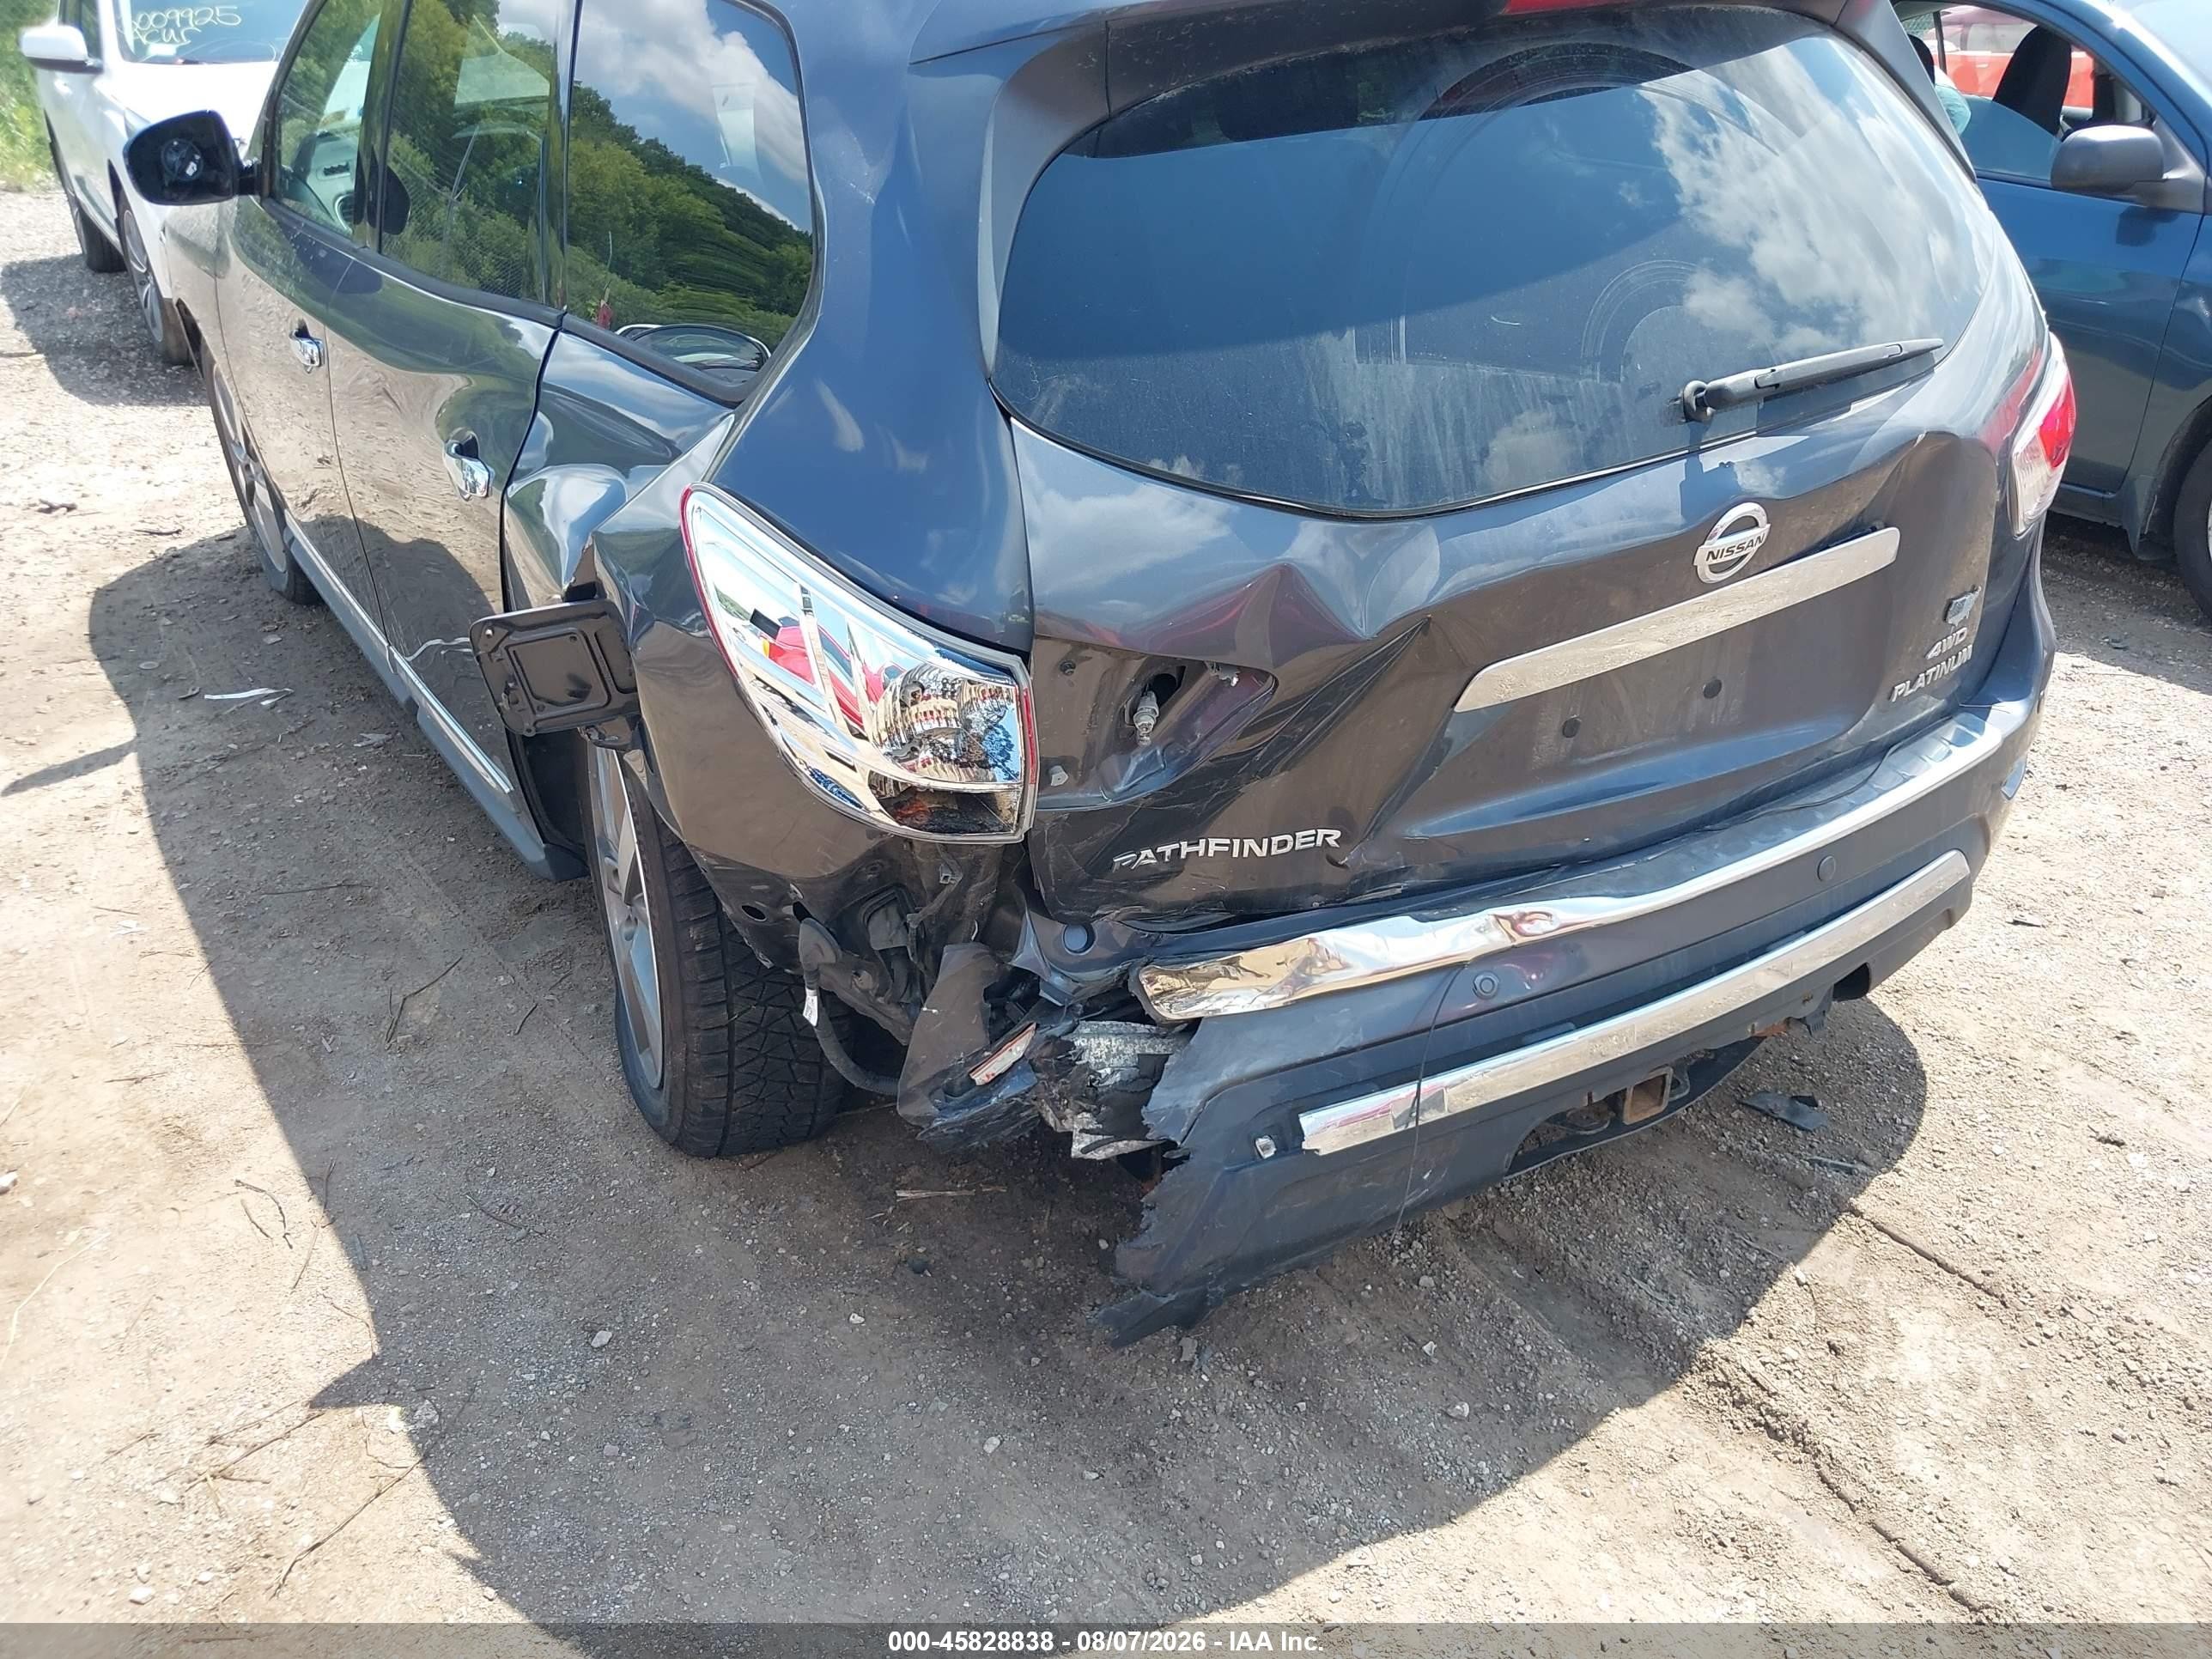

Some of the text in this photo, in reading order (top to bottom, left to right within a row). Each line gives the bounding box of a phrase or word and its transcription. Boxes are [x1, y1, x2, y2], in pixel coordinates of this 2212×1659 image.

[1705, 532, 1766, 562] NISSAN
[1925, 626, 1968, 660] 4WD
[1891, 644, 1973, 702] PLATINUM
[1112, 829, 1341, 873] PATHFINDER
